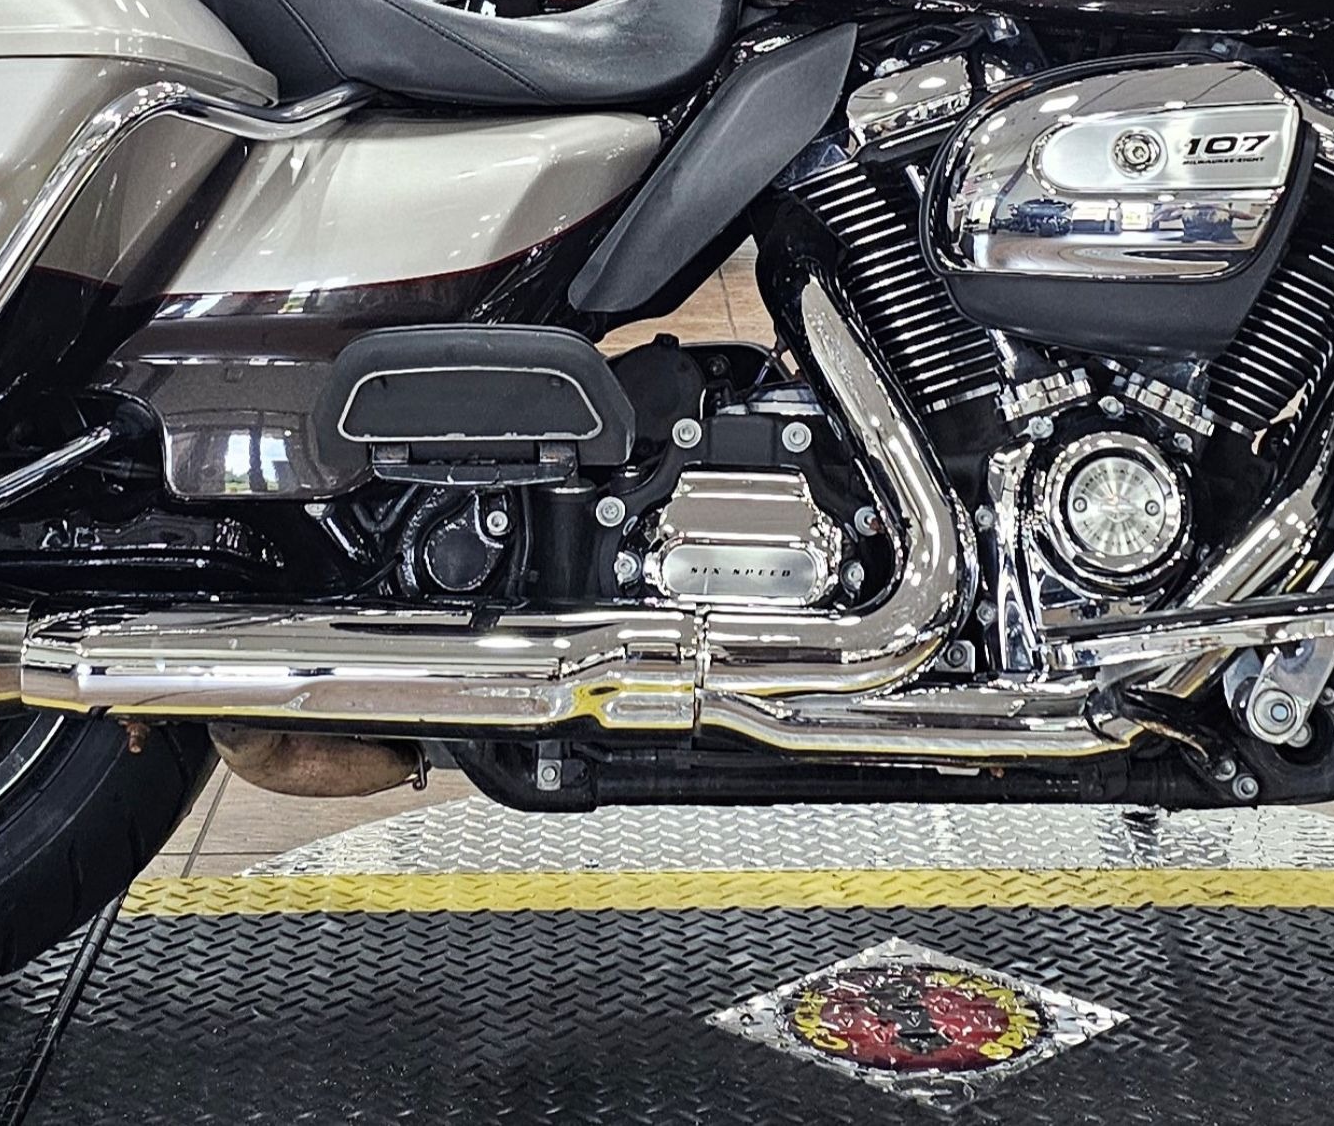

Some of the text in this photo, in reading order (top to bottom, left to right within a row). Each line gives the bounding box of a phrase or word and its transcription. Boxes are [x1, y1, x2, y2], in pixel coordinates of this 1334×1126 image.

[1184, 133, 1272, 156] 107
[690, 566, 791, 578] SIX SPEED
